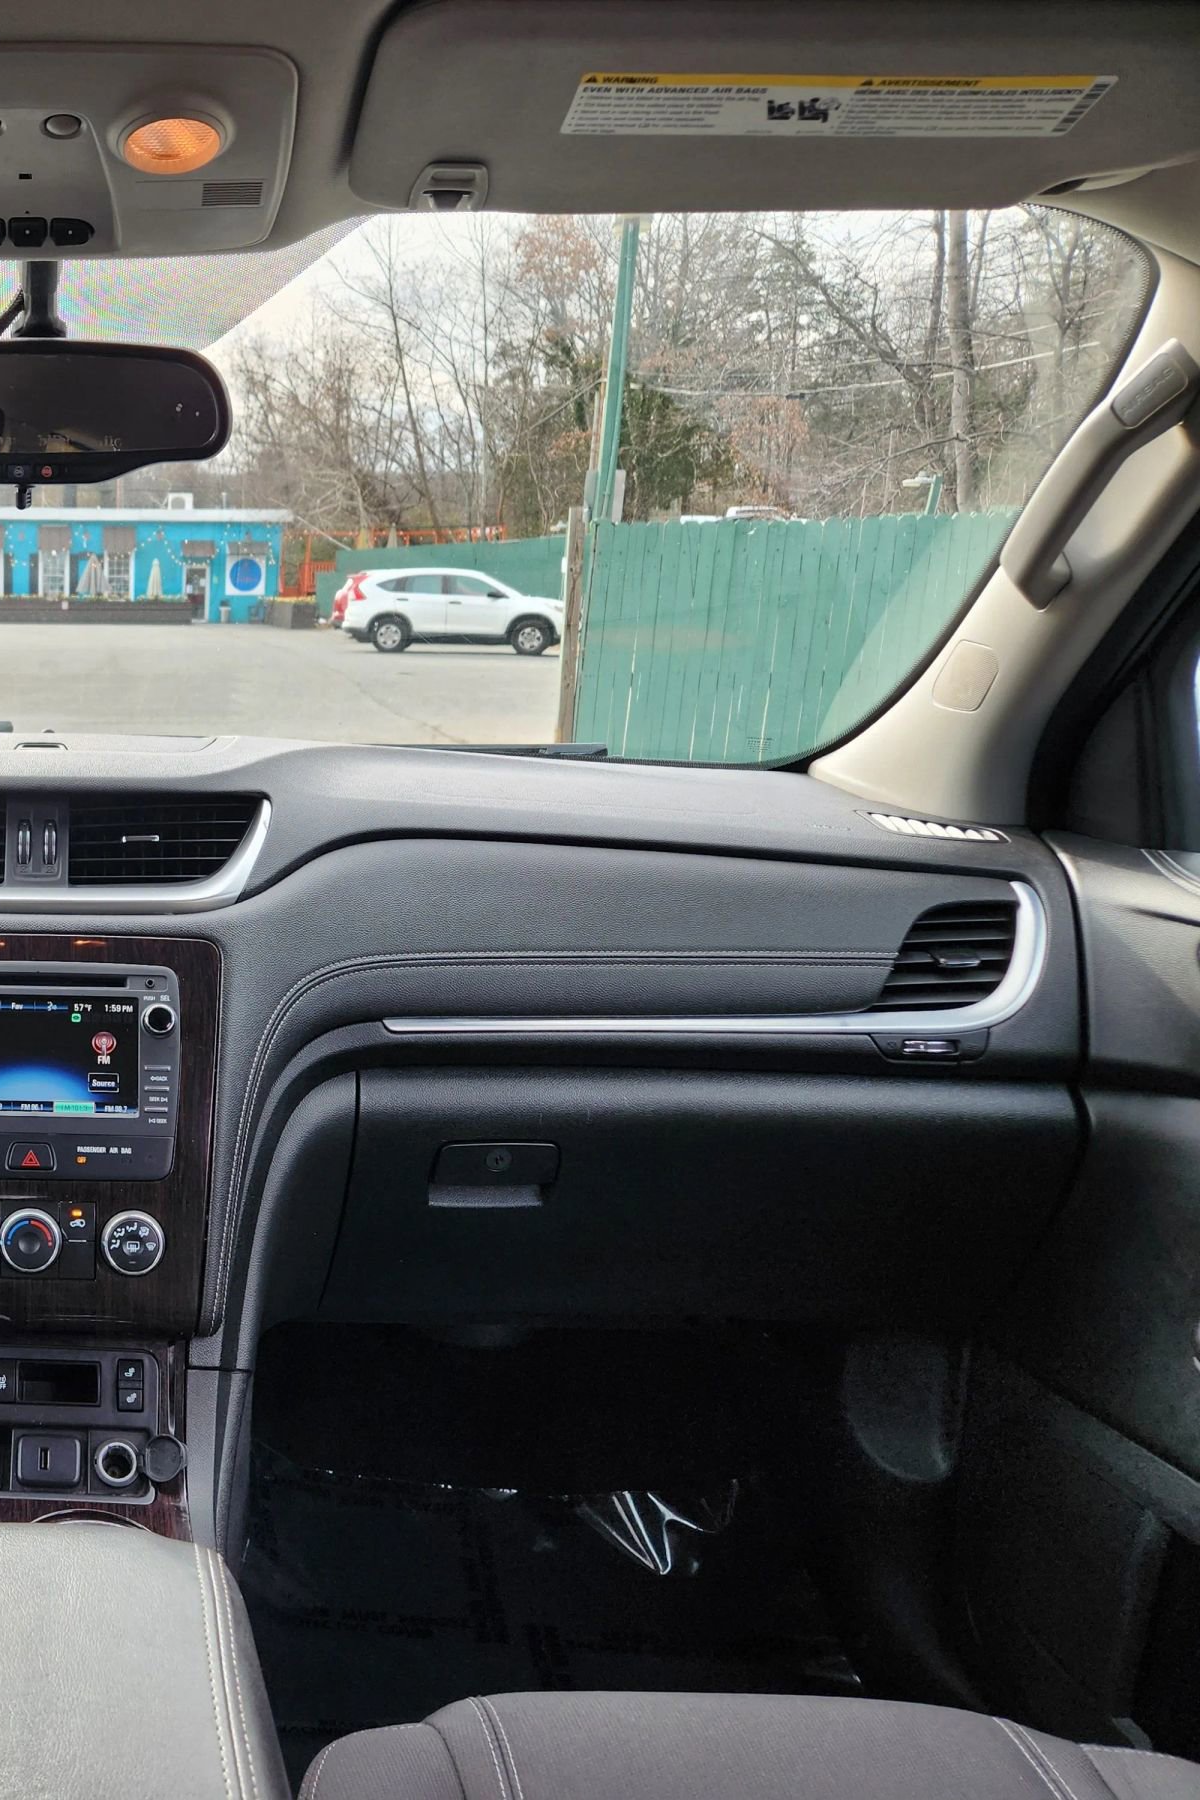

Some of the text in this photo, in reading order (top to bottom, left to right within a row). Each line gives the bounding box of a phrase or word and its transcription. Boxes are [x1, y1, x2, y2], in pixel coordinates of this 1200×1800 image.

[603, 76, 658, 84] WARNING
[878, 79, 982, 87] AVERTISSEMENT
[11, 1002, 24, 1010] Fav
[104, 1004, 122, 1012] 1:59
[97, 1056, 111, 1065] FM
[92, 1079, 116, 1087] Source
[76, 1156, 87, 1164] OFF
